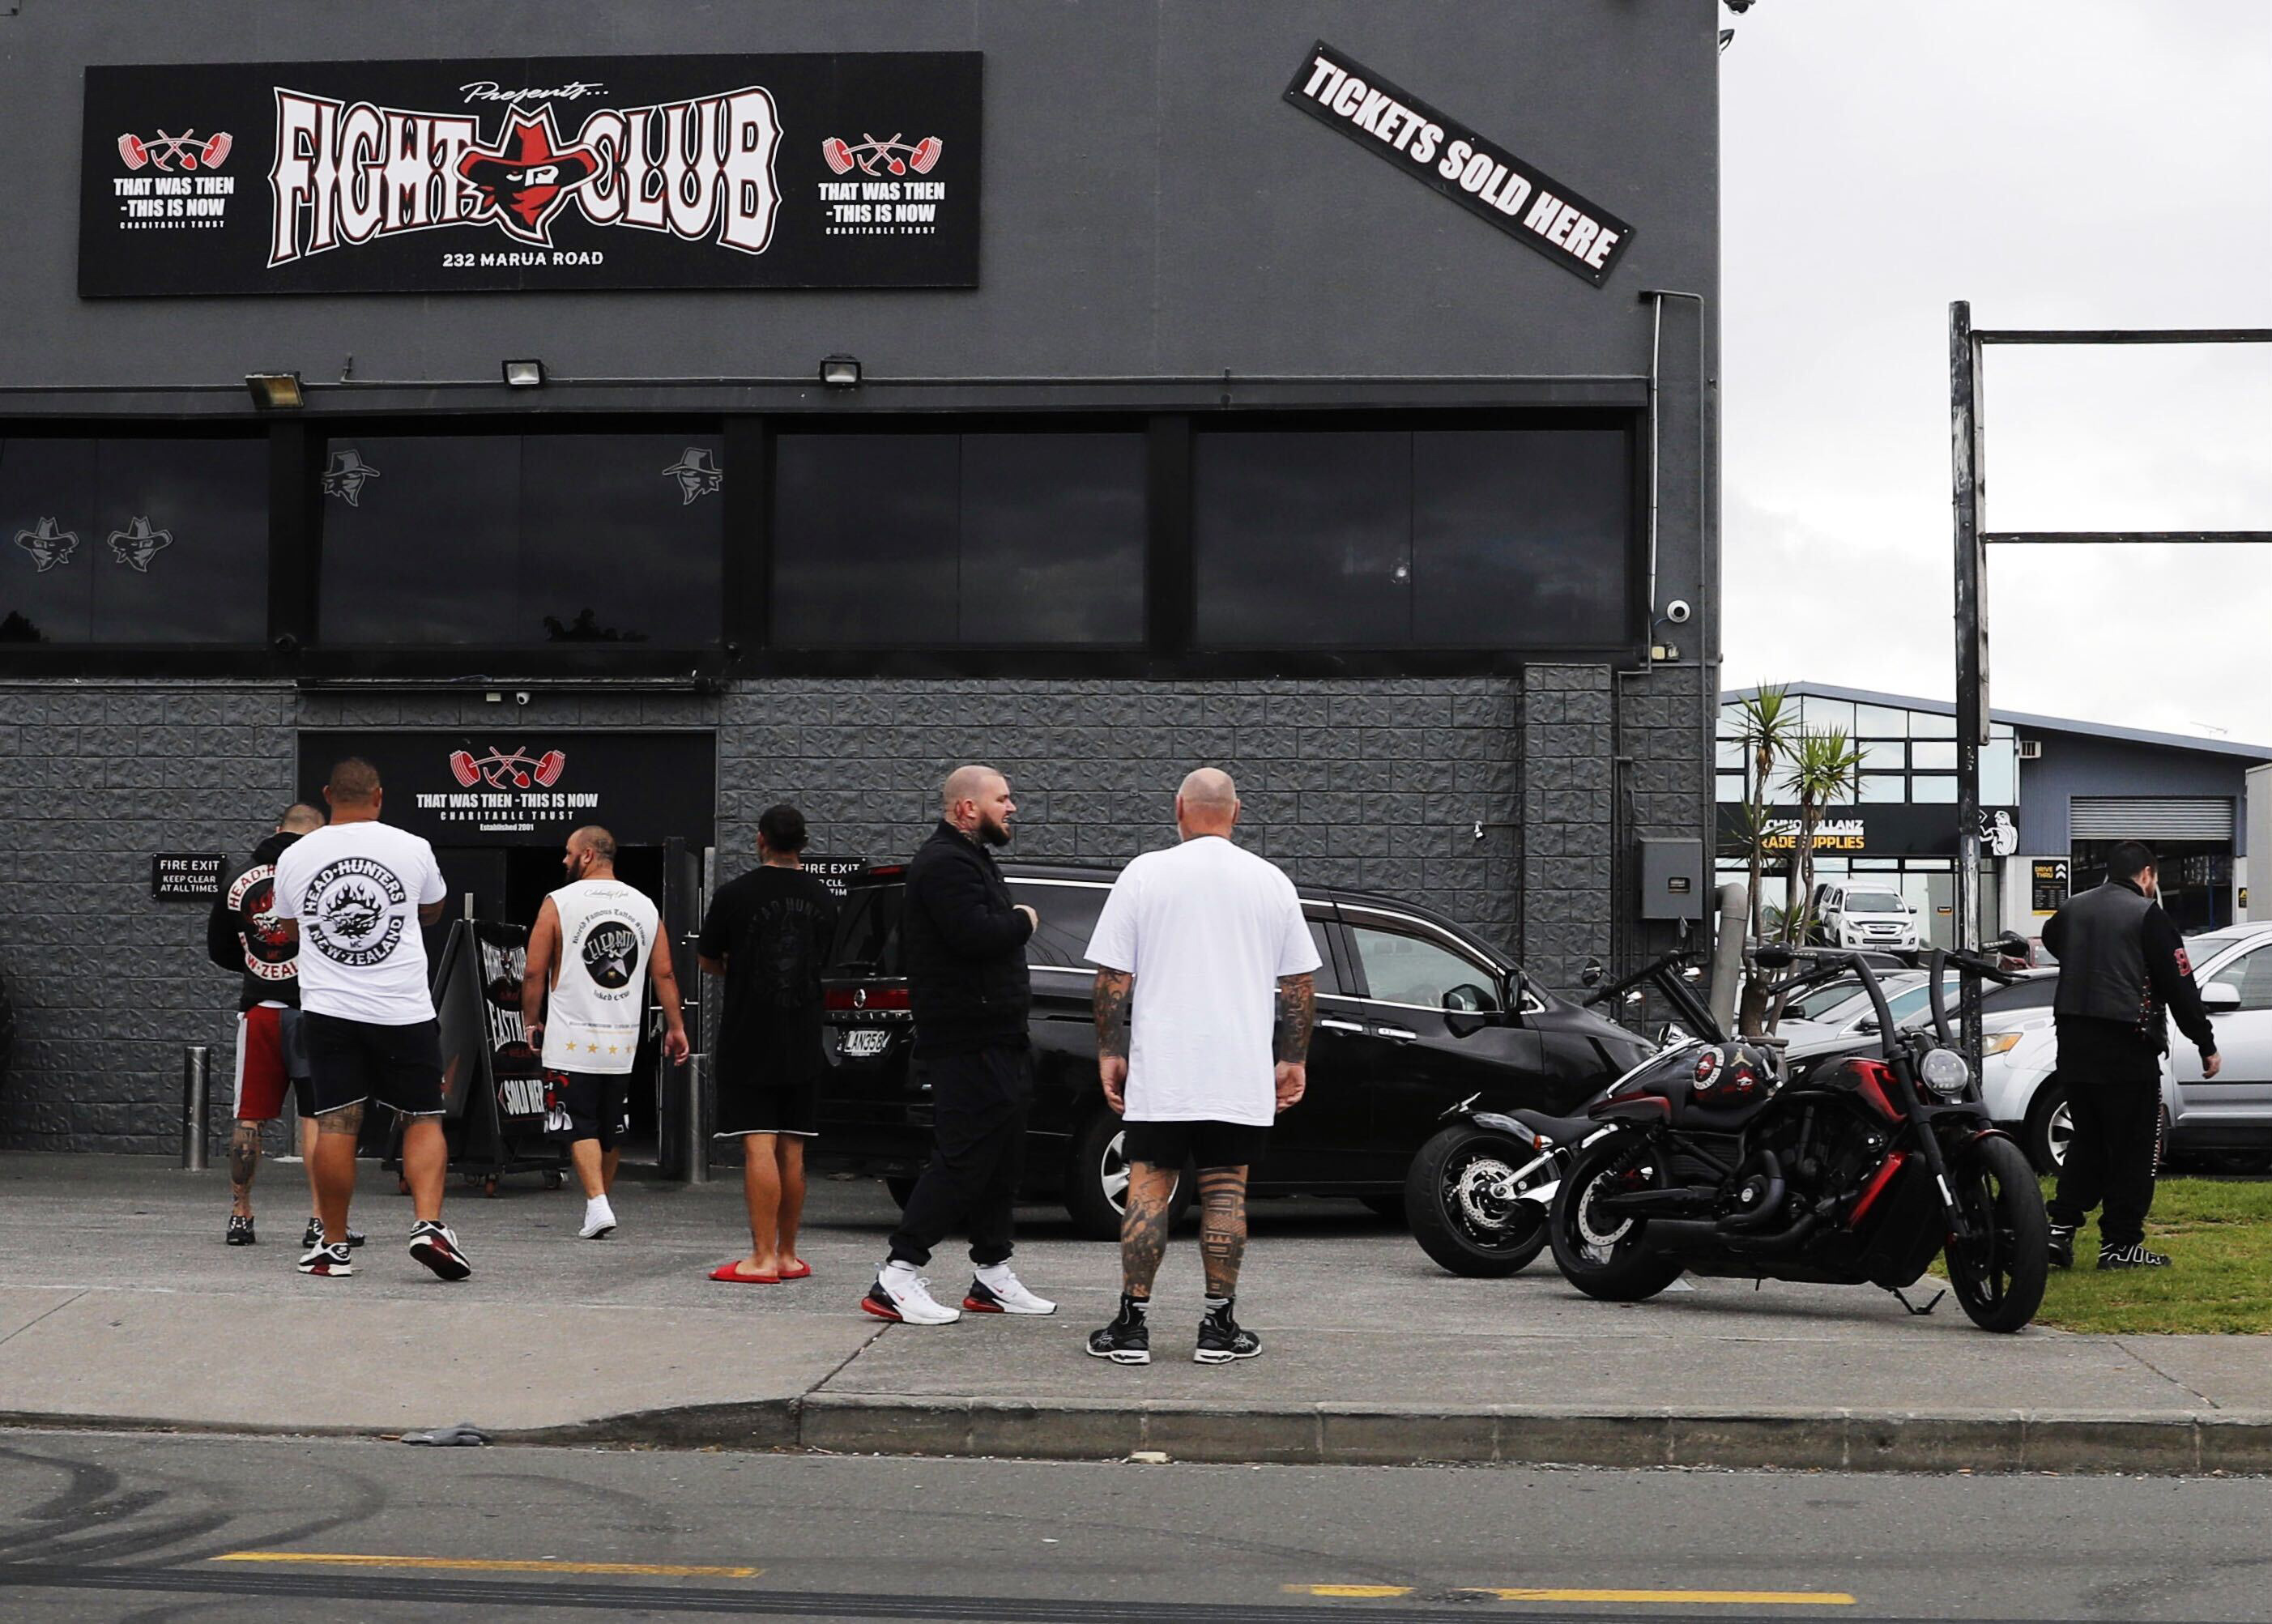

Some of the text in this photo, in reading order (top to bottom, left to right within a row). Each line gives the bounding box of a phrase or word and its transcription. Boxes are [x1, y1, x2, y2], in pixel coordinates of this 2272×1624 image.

[1303, 56, 1619, 270] TICKETS SOLD HERE
[266, 85, 784, 268] FIGHT CLUB
[113, 177, 234, 195] THAT WAS THEN
[818, 182, 945, 200] THAT WAS THEN
[167, 198, 183, 216] IS
[186, 198, 225, 216] NOW
[875, 204, 892, 222] IS
[895, 204, 936, 222] NOW
[443, 252, 603, 266] 232 MARUA ROAD
[416, 794, 447, 808] THAT
[449, 794, 478, 808] WAS
[480, 794, 512, 808] THEN
[552, 794, 565, 808] IS
[568, 794, 598, 808] NOW
[441, 811, 573, 821] CHARITABLE TRUST
[1761, 836, 1865, 849] RADE UPPLIES
[160, 860, 220, 871] FIRE EXIT
[830, 863, 859, 873] EXIT
[191, 884, 219, 893] TIMES
[826, 879, 846, 887] CLE
[504, 1079, 545, 1115] SOLD HER
